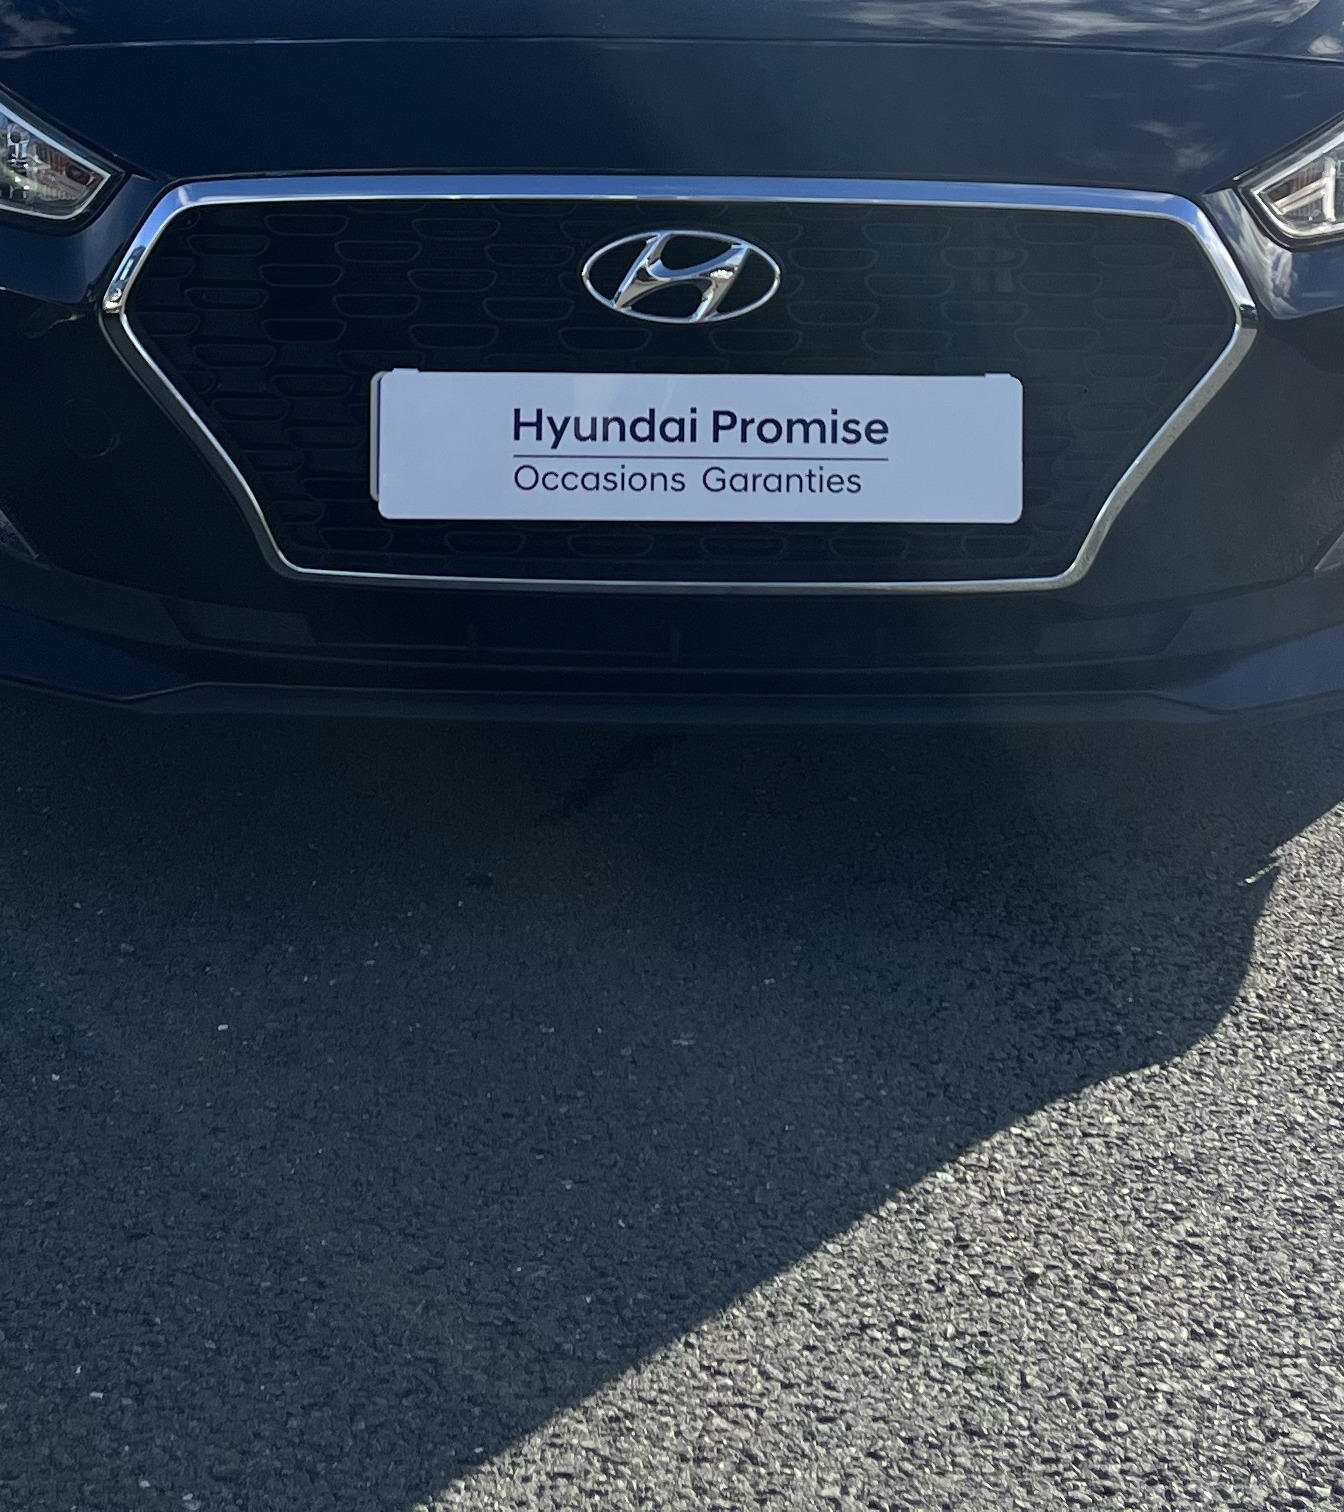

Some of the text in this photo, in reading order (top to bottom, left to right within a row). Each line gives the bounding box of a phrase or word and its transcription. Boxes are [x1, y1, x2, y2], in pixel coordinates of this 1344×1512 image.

[513, 407, 890, 450] Hyundai Promise
[513, 463, 863, 494] Occasions Garanties
